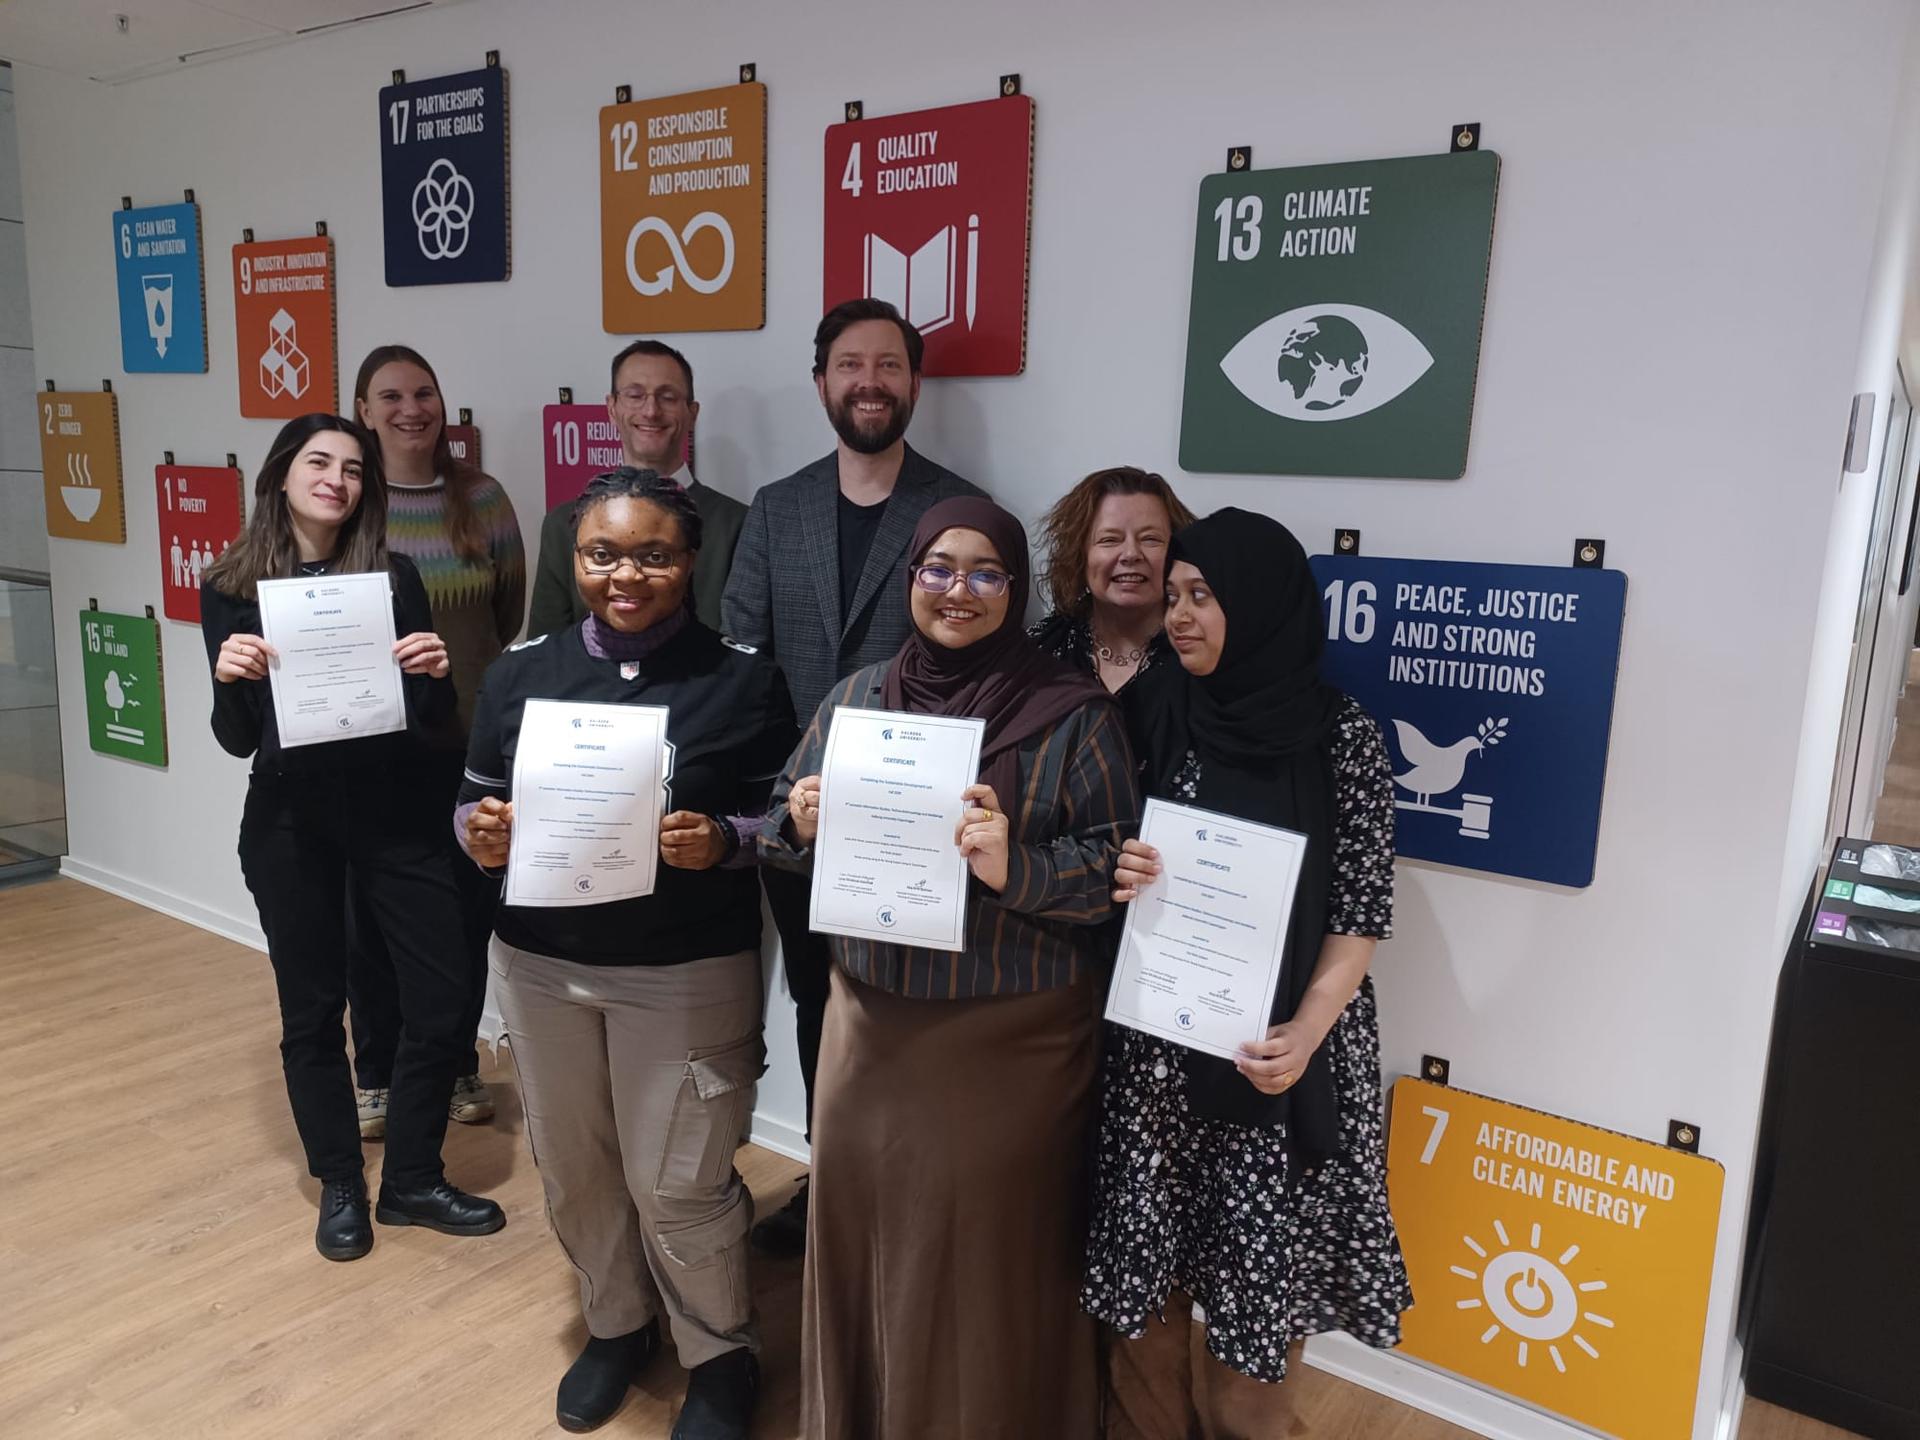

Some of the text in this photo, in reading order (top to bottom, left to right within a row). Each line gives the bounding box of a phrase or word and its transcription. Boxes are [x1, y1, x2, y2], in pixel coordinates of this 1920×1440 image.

[416, 87, 484, 117] PARTNERSHIPS
[389, 100, 409, 145] 17
[417, 113, 484, 141] FOR THE GOALS
[648, 107, 728, 139] RESPONSIBLE
[610, 120, 638, 172] 12
[648, 136, 733, 168] CONSUMPTION
[877, 130, 938, 163] QUALITY
[649, 163, 750, 196] AND PRODUCTION
[841, 142, 863, 197] 4
[877, 161, 958, 194] EDUCATION
[1284, 186, 1372, 221] CLIMATE
[121, 223, 132, 259] 6
[135, 218, 176, 238] CLEAN WATER
[1214, 195, 1263, 262] 13
[1279, 226, 1357, 258] ACTION
[137, 239, 186, 257] AND SANITATION
[287, 252, 327, 270] INNOVATION
[240, 257, 252, 295] 9
[255, 275, 325, 294] AND INFRASTRUCTURE
[44, 404, 54, 434] 2
[587, 422, 621, 441] REDUC
[553, 421, 580, 466] 10
[587, 447, 624, 467] INEQUA
[164, 477, 172, 511] 1
[178, 478, 187, 493] NO
[179, 497, 207, 514] POVERTY
[1324, 579, 1377, 643] 16
[1395, 583, 1579, 622] PEACE, JUSTICE
[85, 622, 101, 653] 15
[103, 624, 115, 639] LIFE
[1391, 621, 1536, 658] AND STRONG
[1388, 655, 1545, 697] INSTITUTIONS
[1420, 1105, 1449, 1165] 7
[1476, 1122, 1675, 1201] AFFORDABLE AND
[1473, 1155, 1648, 1229] CLEAN ENERGY
